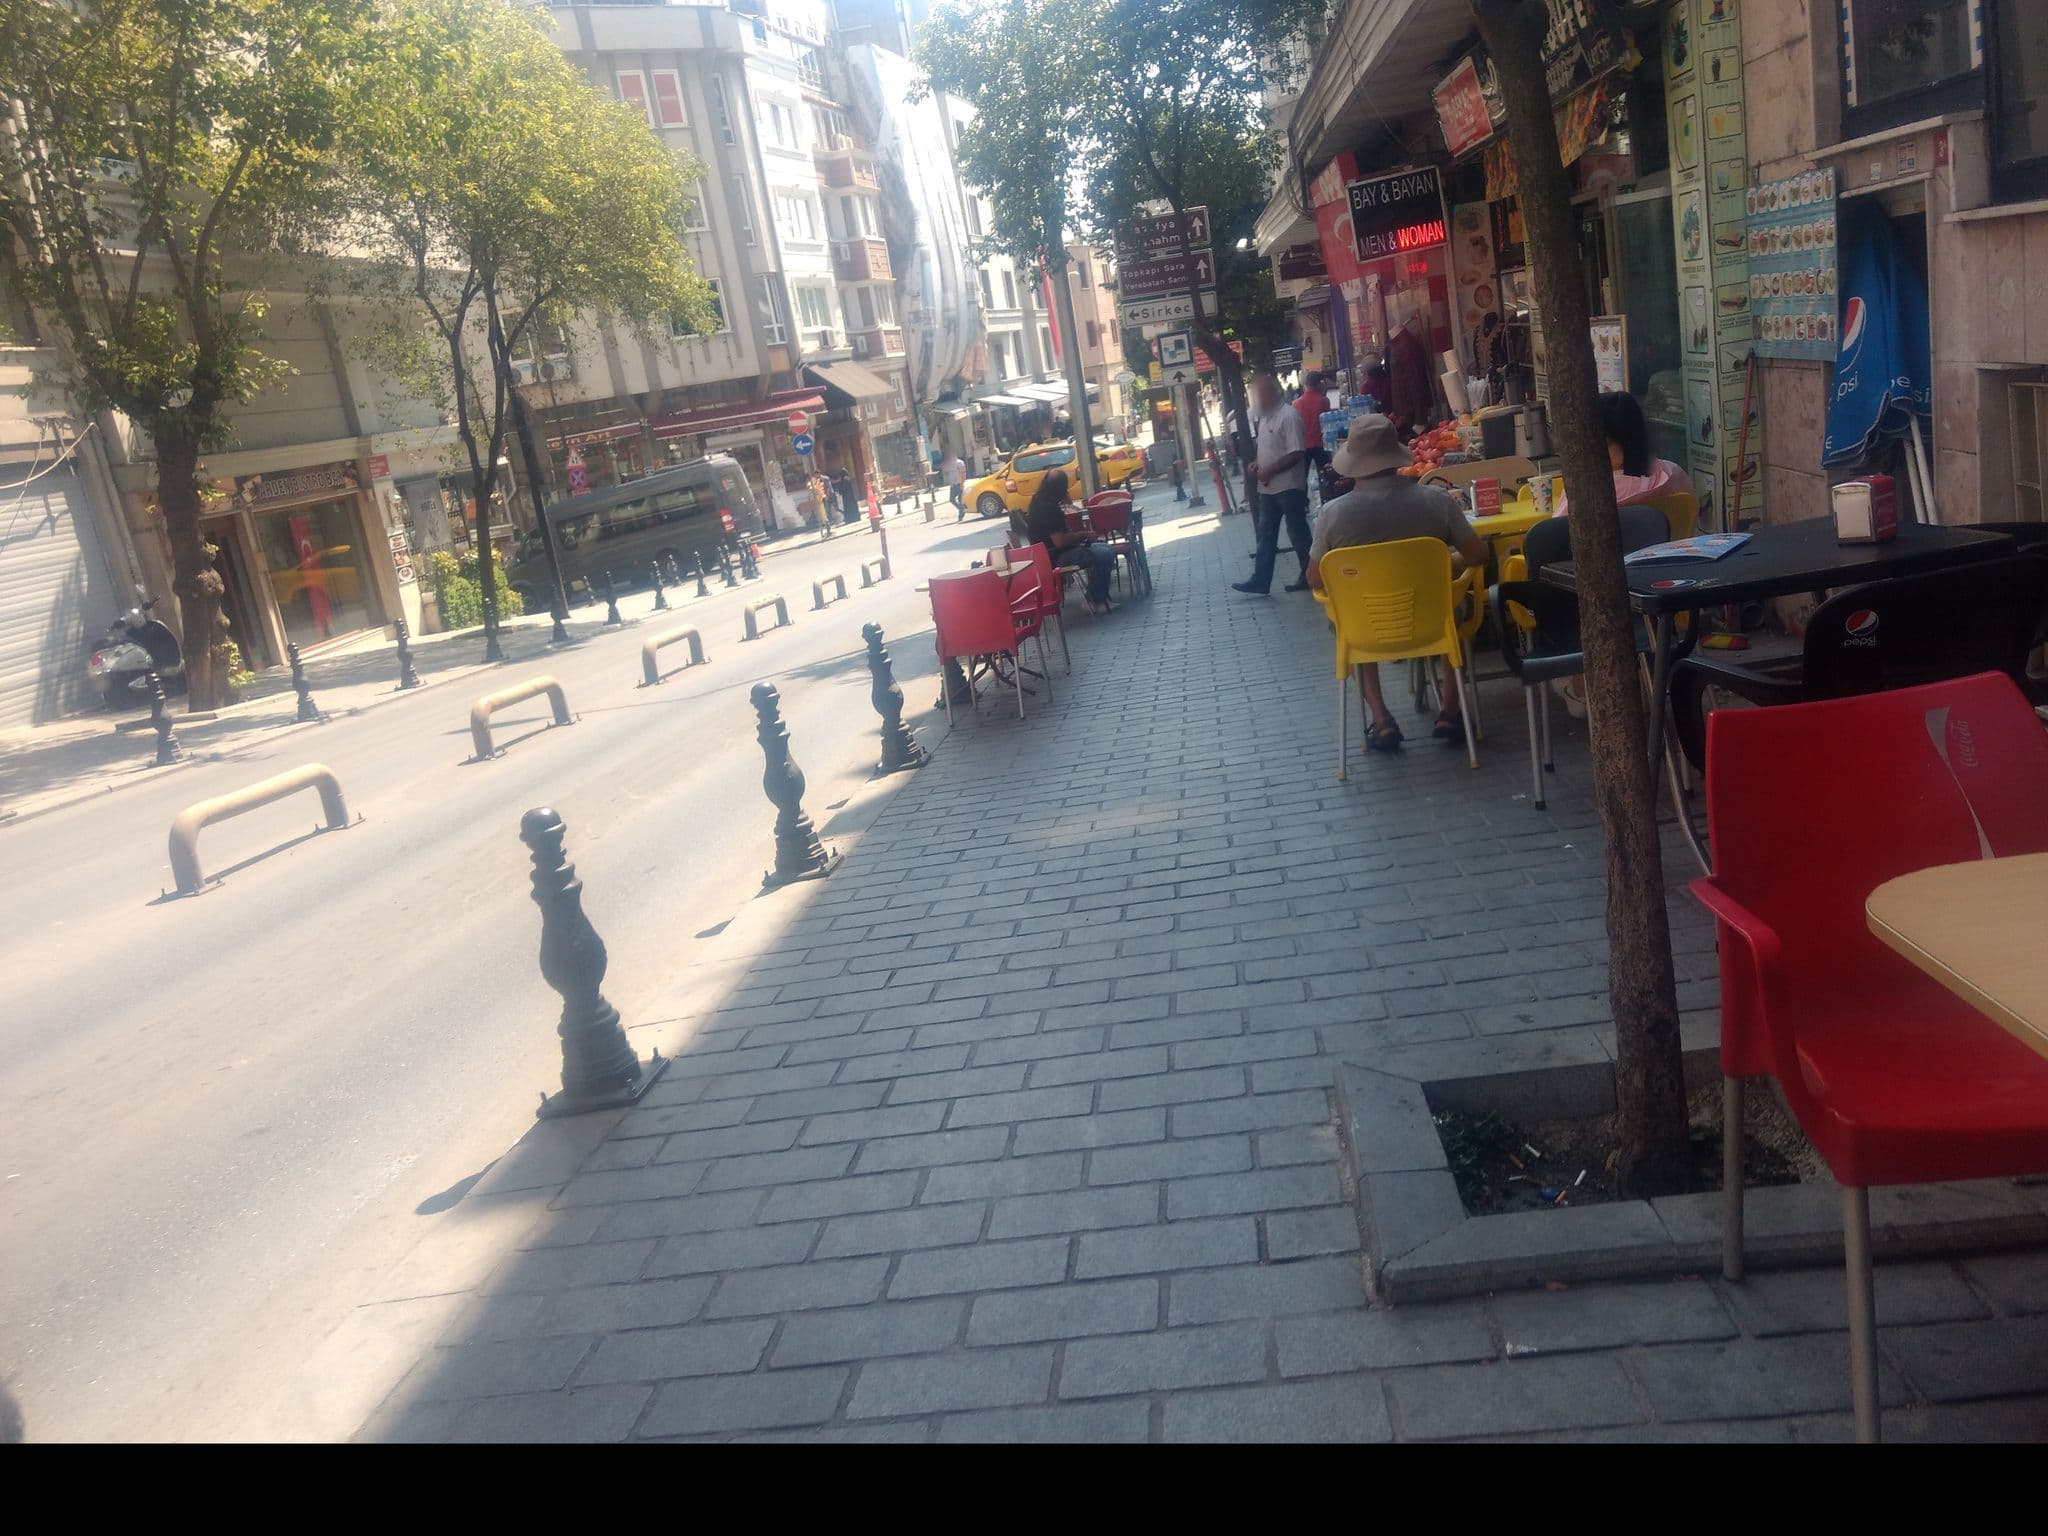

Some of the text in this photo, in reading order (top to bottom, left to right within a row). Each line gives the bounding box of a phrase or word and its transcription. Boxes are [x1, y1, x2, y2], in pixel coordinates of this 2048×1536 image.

[1352, 174, 1434, 210] BAY & BAYAN
[1360, 220, 1444, 257] MEN & WOMAN
[1141, 304, 1191, 319] Sirkec
[292, 474, 324, 494] BISTRO
[1843, 635, 1876, 648] pepsi
